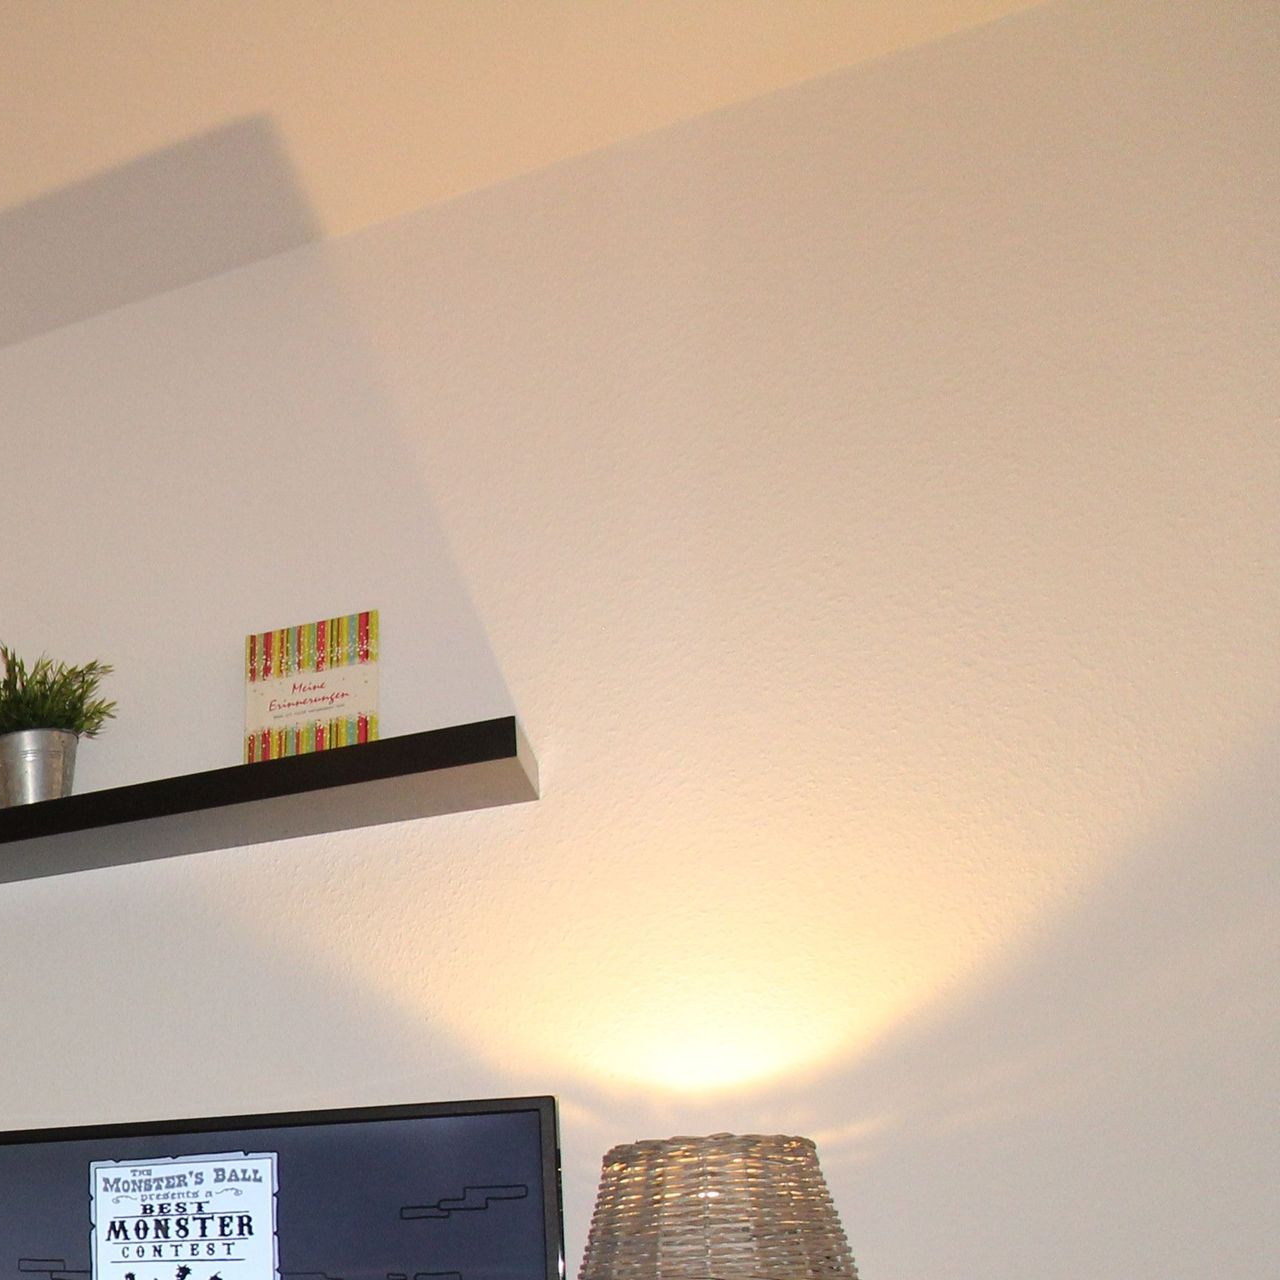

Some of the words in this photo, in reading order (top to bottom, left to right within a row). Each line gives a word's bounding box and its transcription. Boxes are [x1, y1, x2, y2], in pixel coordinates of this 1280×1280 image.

[291, 681, 325, 695] Meine
[268, 691, 350, 712] Erinnerungen
[102, 1171, 204, 1193] MONSTER'S
[213, 1168, 263, 1183] BALL
[130, 1169, 152, 1177] THE
[140, 1190, 200, 1202] presents
[140, 1201, 210, 1215] BEST
[105, 1214, 255, 1241] MONSTER
[121, 1242, 236, 1258] CONTEST
